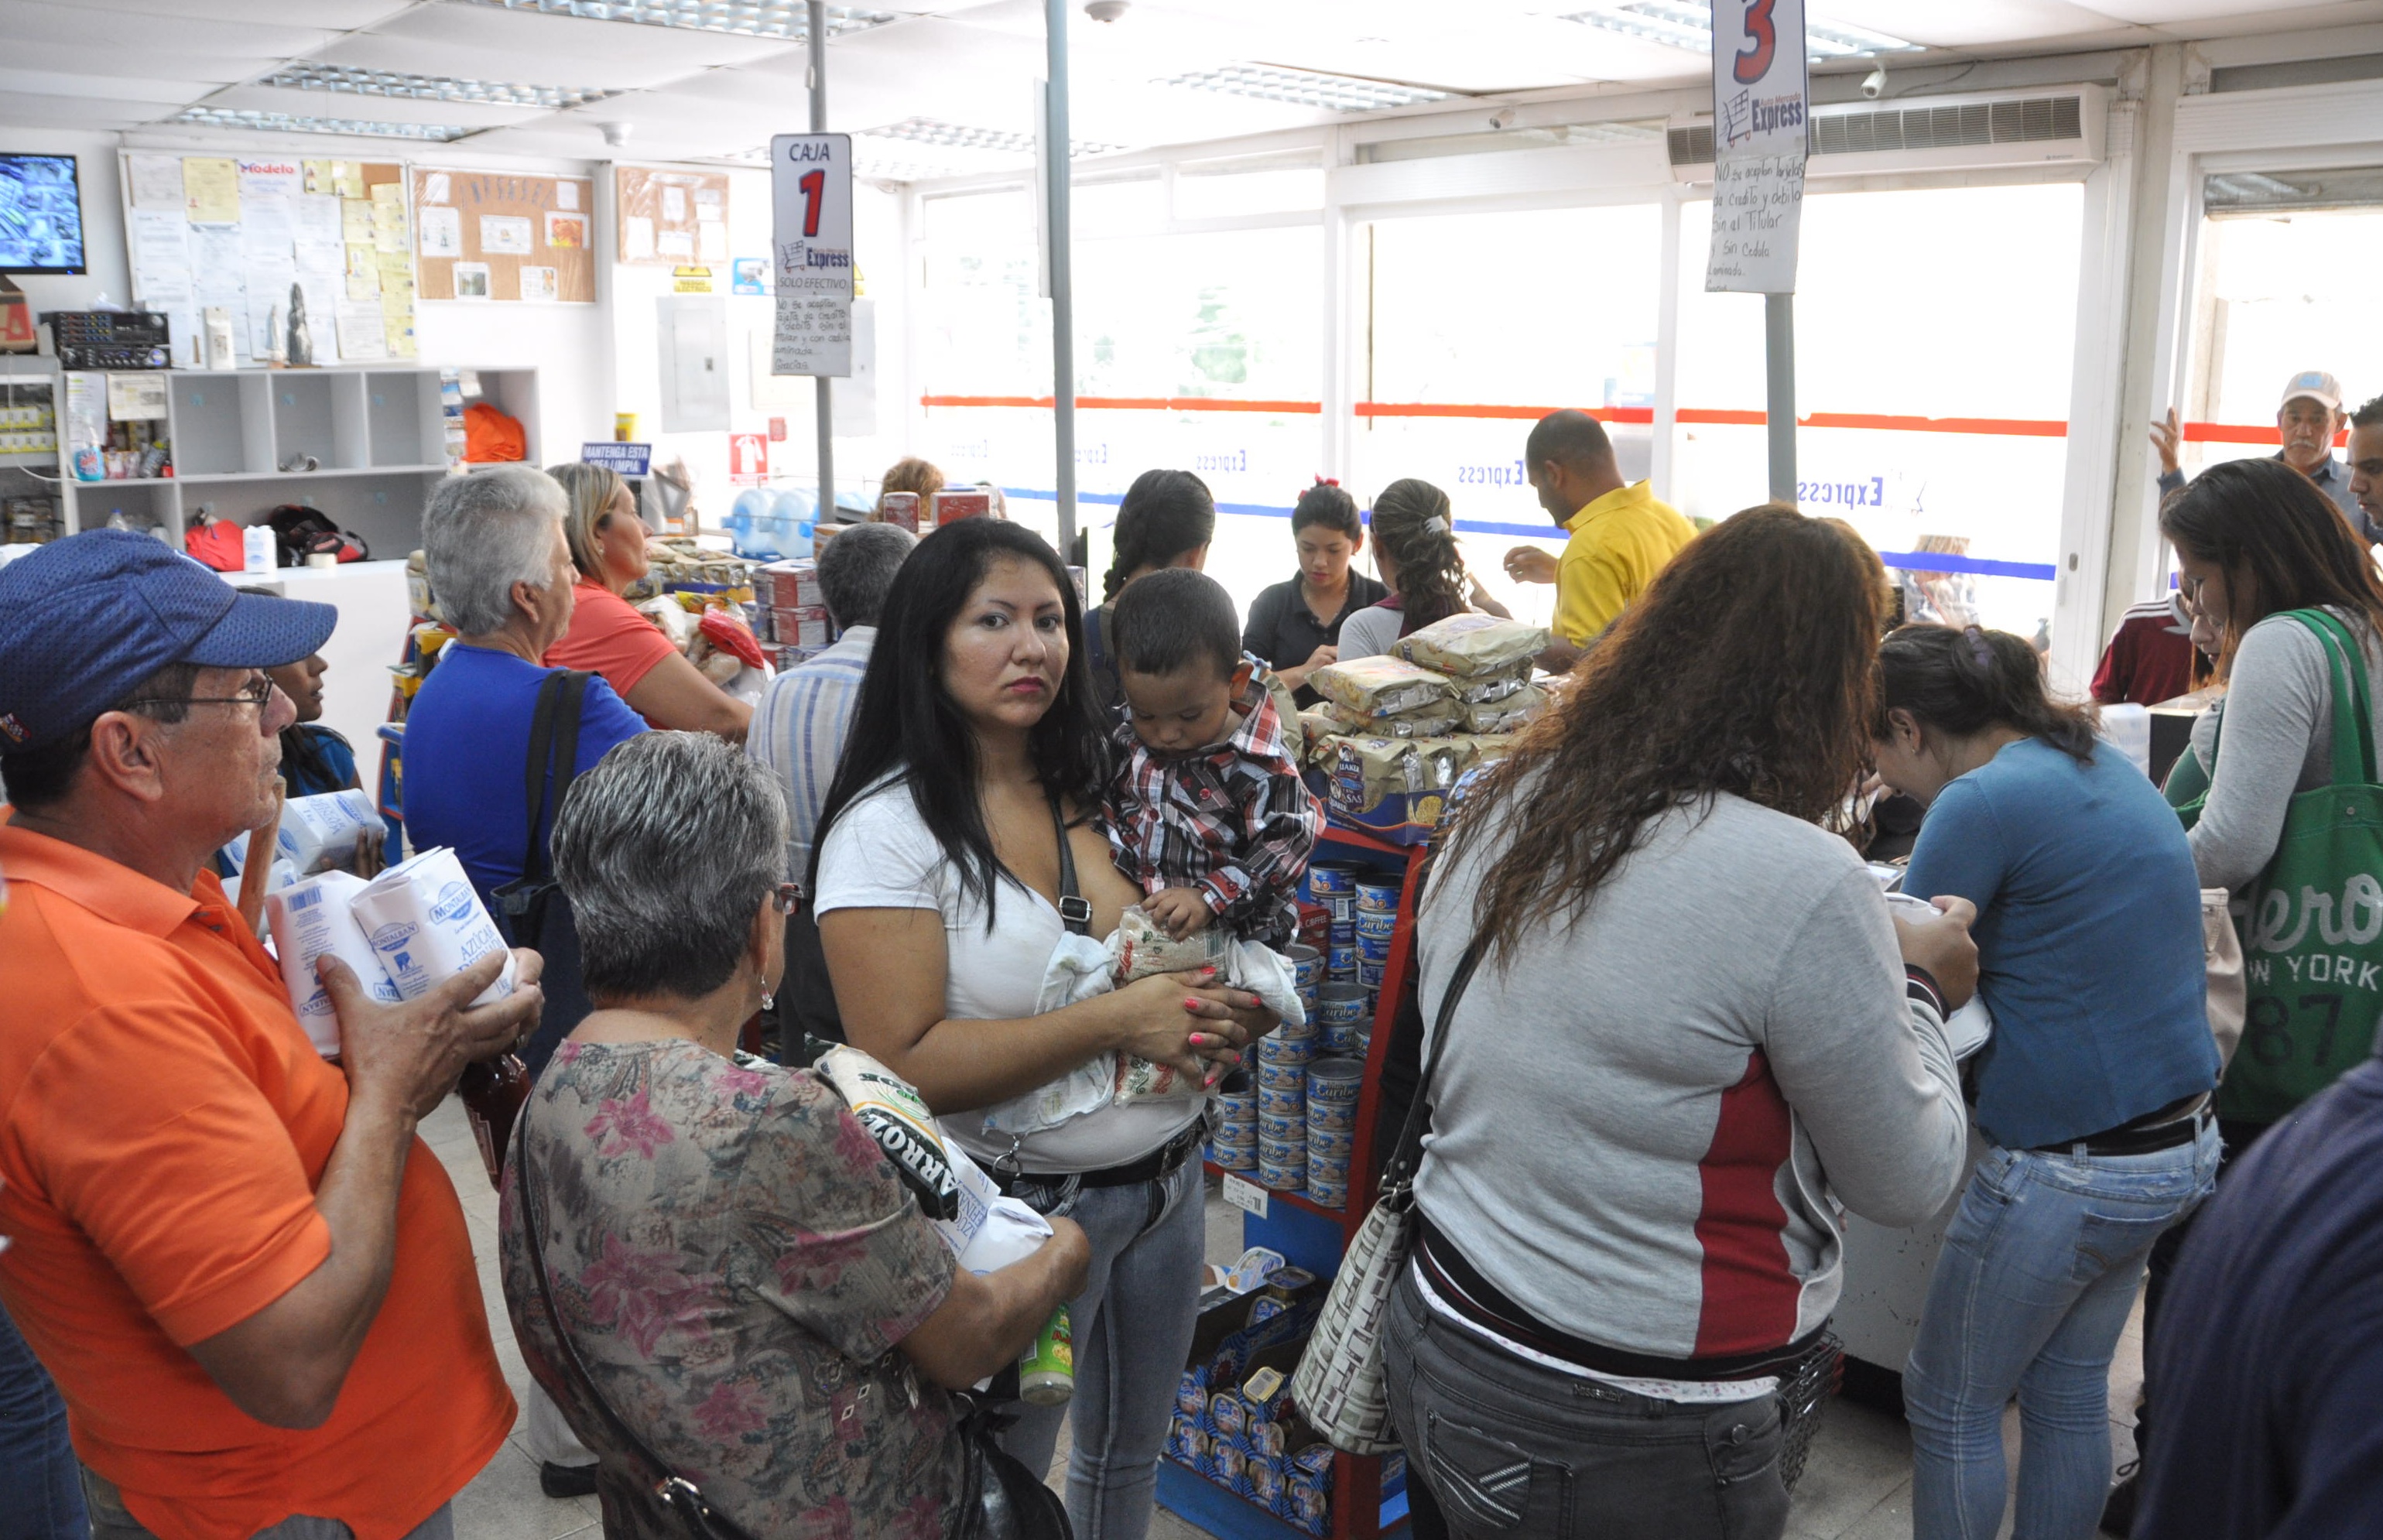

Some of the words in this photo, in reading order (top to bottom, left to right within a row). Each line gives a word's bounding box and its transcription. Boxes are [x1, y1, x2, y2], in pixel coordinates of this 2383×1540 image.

[1734, 0, 1776, 84] 3
[1775, 91, 1802, 105] Mercado
[1751, 99, 1803, 135] Express
[789, 142, 830, 162] CAJA
[799, 168, 825, 238] 1
[806, 247, 848, 269] Express
[779, 276, 803, 288] SOLO
[804, 277, 847, 289] EFECTIVO
[584, 445, 626, 459] MANTENGA
[628, 446, 649, 459] ESTA
[610, 459, 639, 473] LIMPIA
[1339, 763, 1360, 774] UAKER
[1305, 914, 1328, 929] COFFEE
[1358, 916, 1393, 933] Caribe
[2285, 954, 2381, 991] YORK
[2247, 994, 2344, 1066] 87
